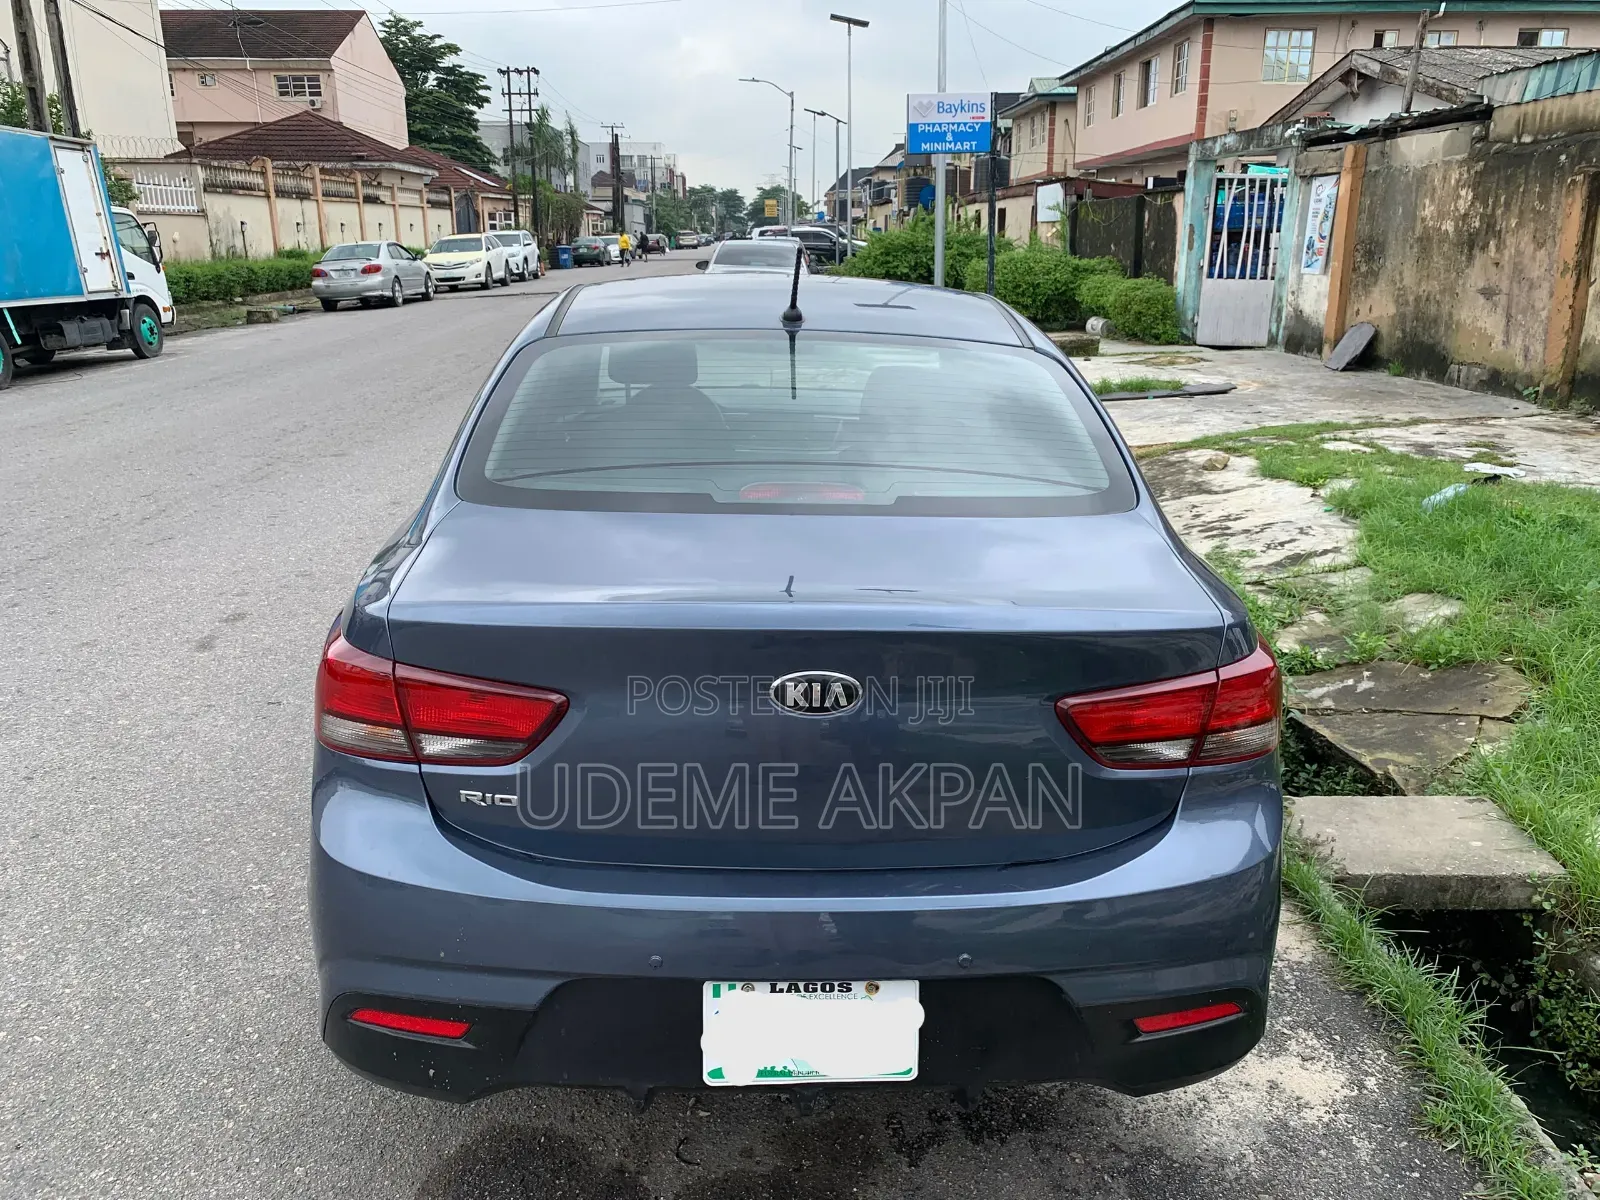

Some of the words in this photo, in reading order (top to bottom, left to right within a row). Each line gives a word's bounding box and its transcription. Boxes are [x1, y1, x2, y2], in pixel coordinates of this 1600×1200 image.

[936, 99, 986, 118] Baykins
[918, 123, 981, 133] PHARMACY
[945, 132, 953, 142] &
[921, 141, 977, 151] MINIMART
[785, 682, 848, 707] KIA
[459, 789, 518, 807] RIO
[769, 982, 853, 994] LAGOS
